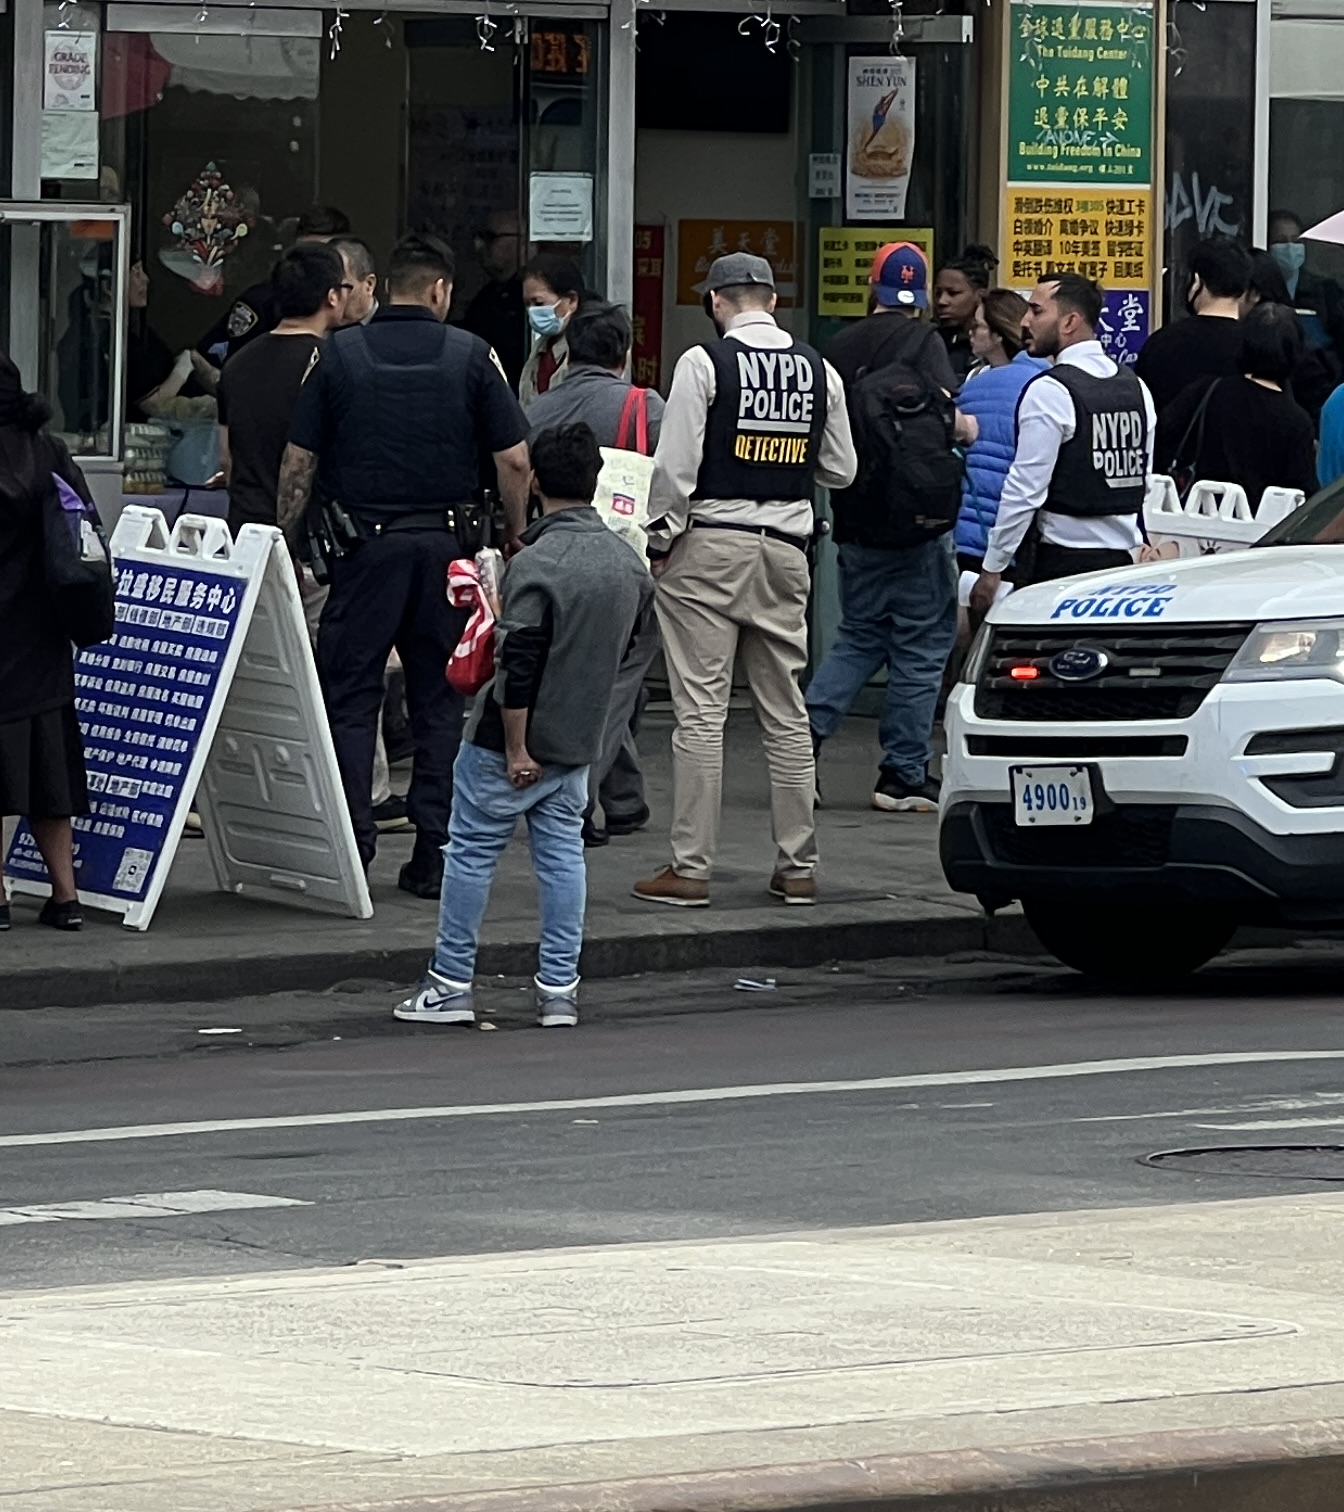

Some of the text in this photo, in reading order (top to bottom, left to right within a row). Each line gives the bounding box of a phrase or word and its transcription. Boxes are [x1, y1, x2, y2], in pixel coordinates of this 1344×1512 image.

[1037, 45, 1128, 61] The Tuidang Center
[856, 75, 907, 88] SHEN YUN
[1019, 141, 1058, 158] Building
[1114, 143, 1141, 157] China
[736, 351, 814, 392] NYPD
[738, 389, 814, 421] POLICE
[1091, 410, 1143, 453] NYPD
[735, 434, 809, 464] DETECTIVE
[1091, 446, 1144, 479] POLICE
[1049, 596, 1174, 619] POLICE
[1022, 781, 1070, 813] 4900
